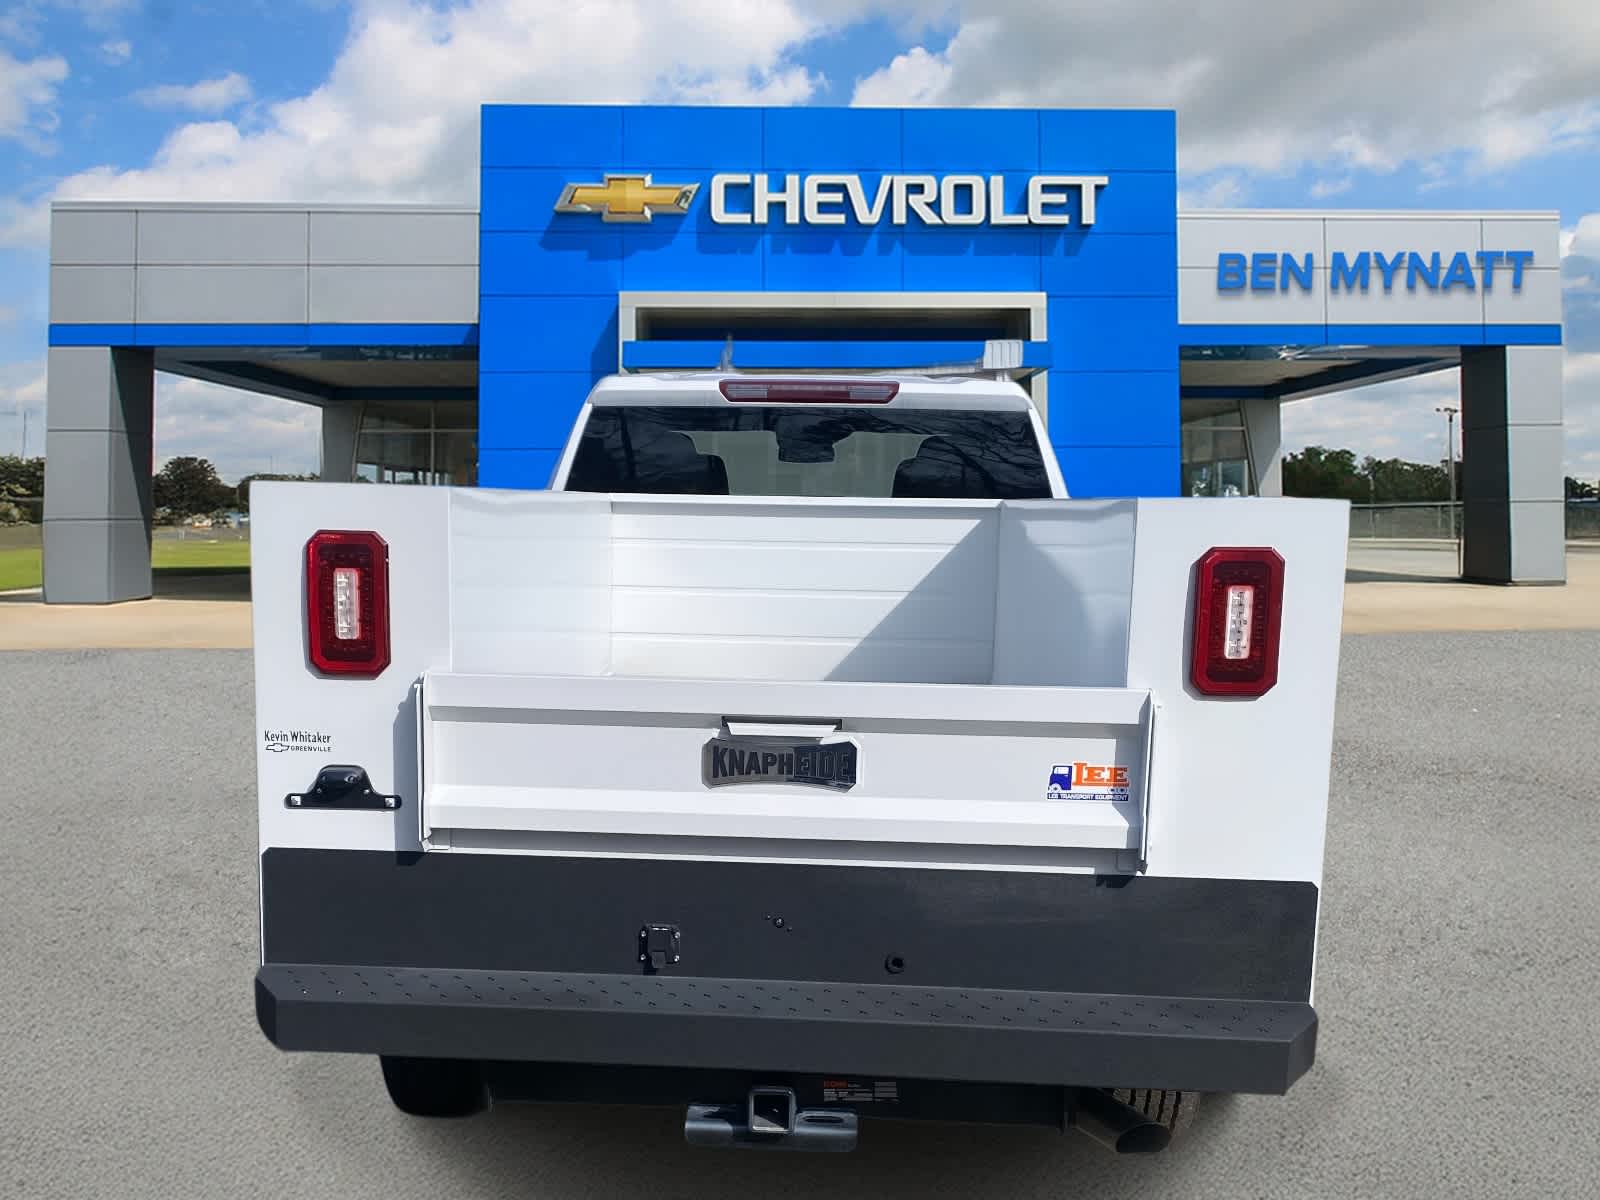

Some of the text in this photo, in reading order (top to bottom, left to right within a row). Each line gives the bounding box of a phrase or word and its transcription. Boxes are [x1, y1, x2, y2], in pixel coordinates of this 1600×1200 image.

[710, 173, 1109, 226] CHEVROLET
[1217, 250, 1534, 290] BEN MYNATT
[264, 730, 331, 743] Kevin Whitaker
[712, 745, 850, 779] KNAPHEIDE
[1072, 762, 1129, 786] LEE
